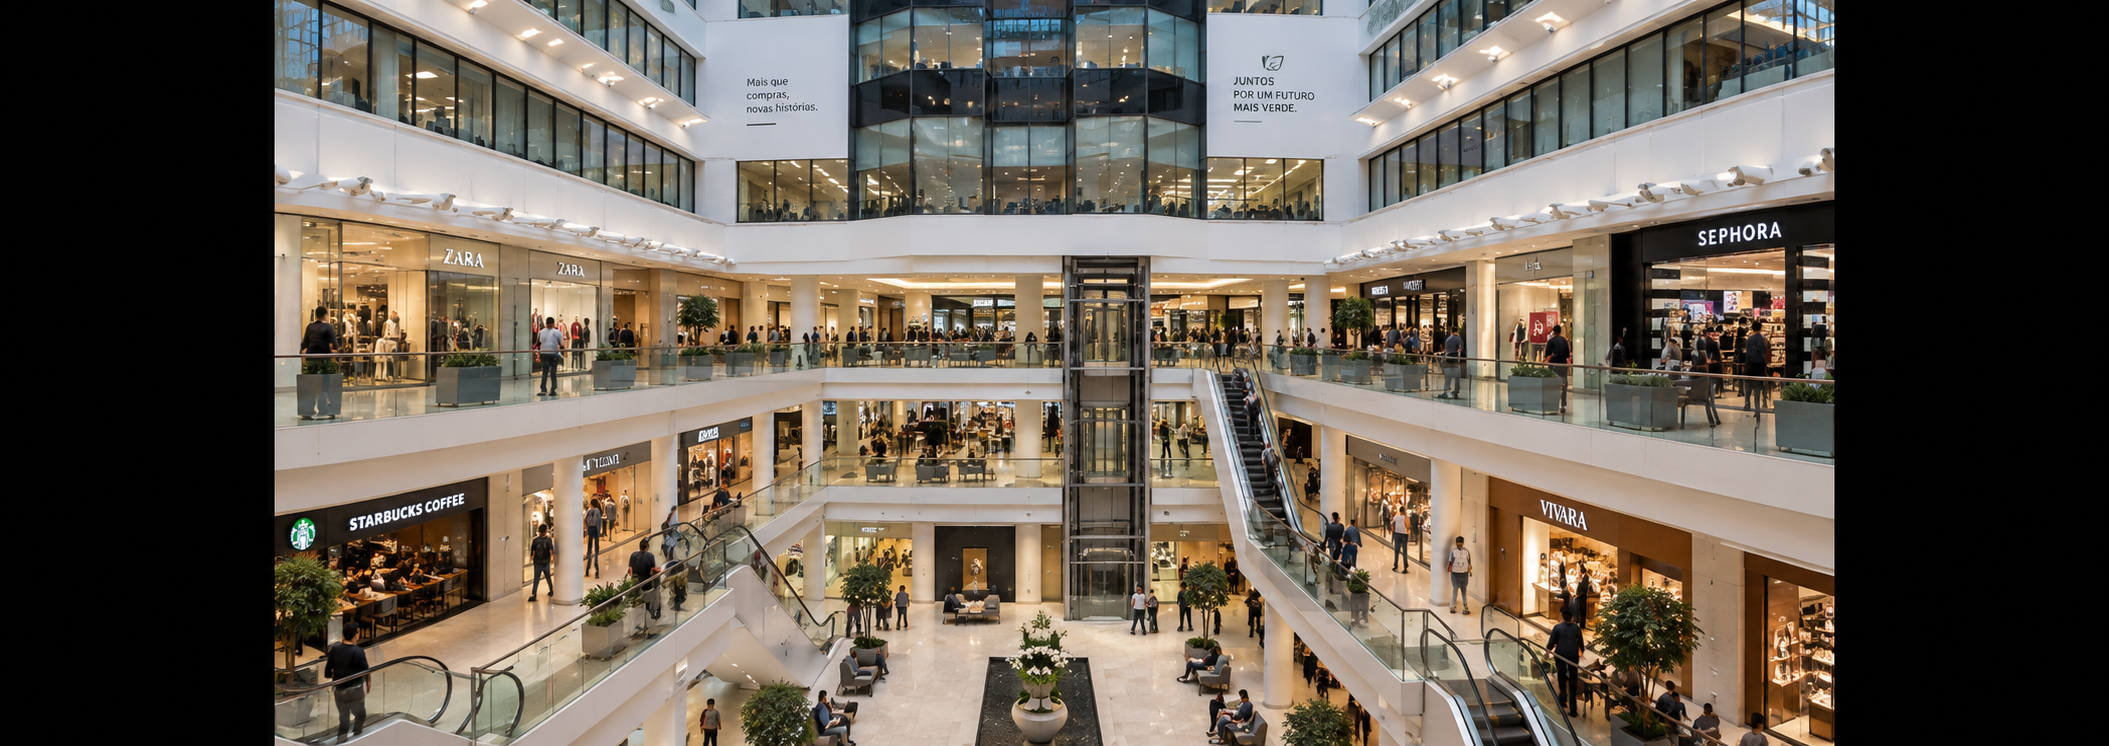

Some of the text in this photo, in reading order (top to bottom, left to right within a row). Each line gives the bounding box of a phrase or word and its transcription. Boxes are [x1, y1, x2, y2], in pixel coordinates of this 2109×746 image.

[746, 77, 789, 87] Mais que
[1233, 76, 1275, 86] JUNTOS
[746, 91, 790, 101] compras,
[1233, 90, 1315, 101] POR UM FUTURO
[746, 105, 774, 113] novas
[1233, 103, 1298, 113] MAIS VERDE.
[1697, 221, 1782, 246] SEPHORA
[443, 248, 485, 268] ZARA
[557, 262, 586, 278] ZARA
[349, 493, 465, 531] STARBUCKS COFFEE
[1539, 499, 1588, 531] VIVARA
